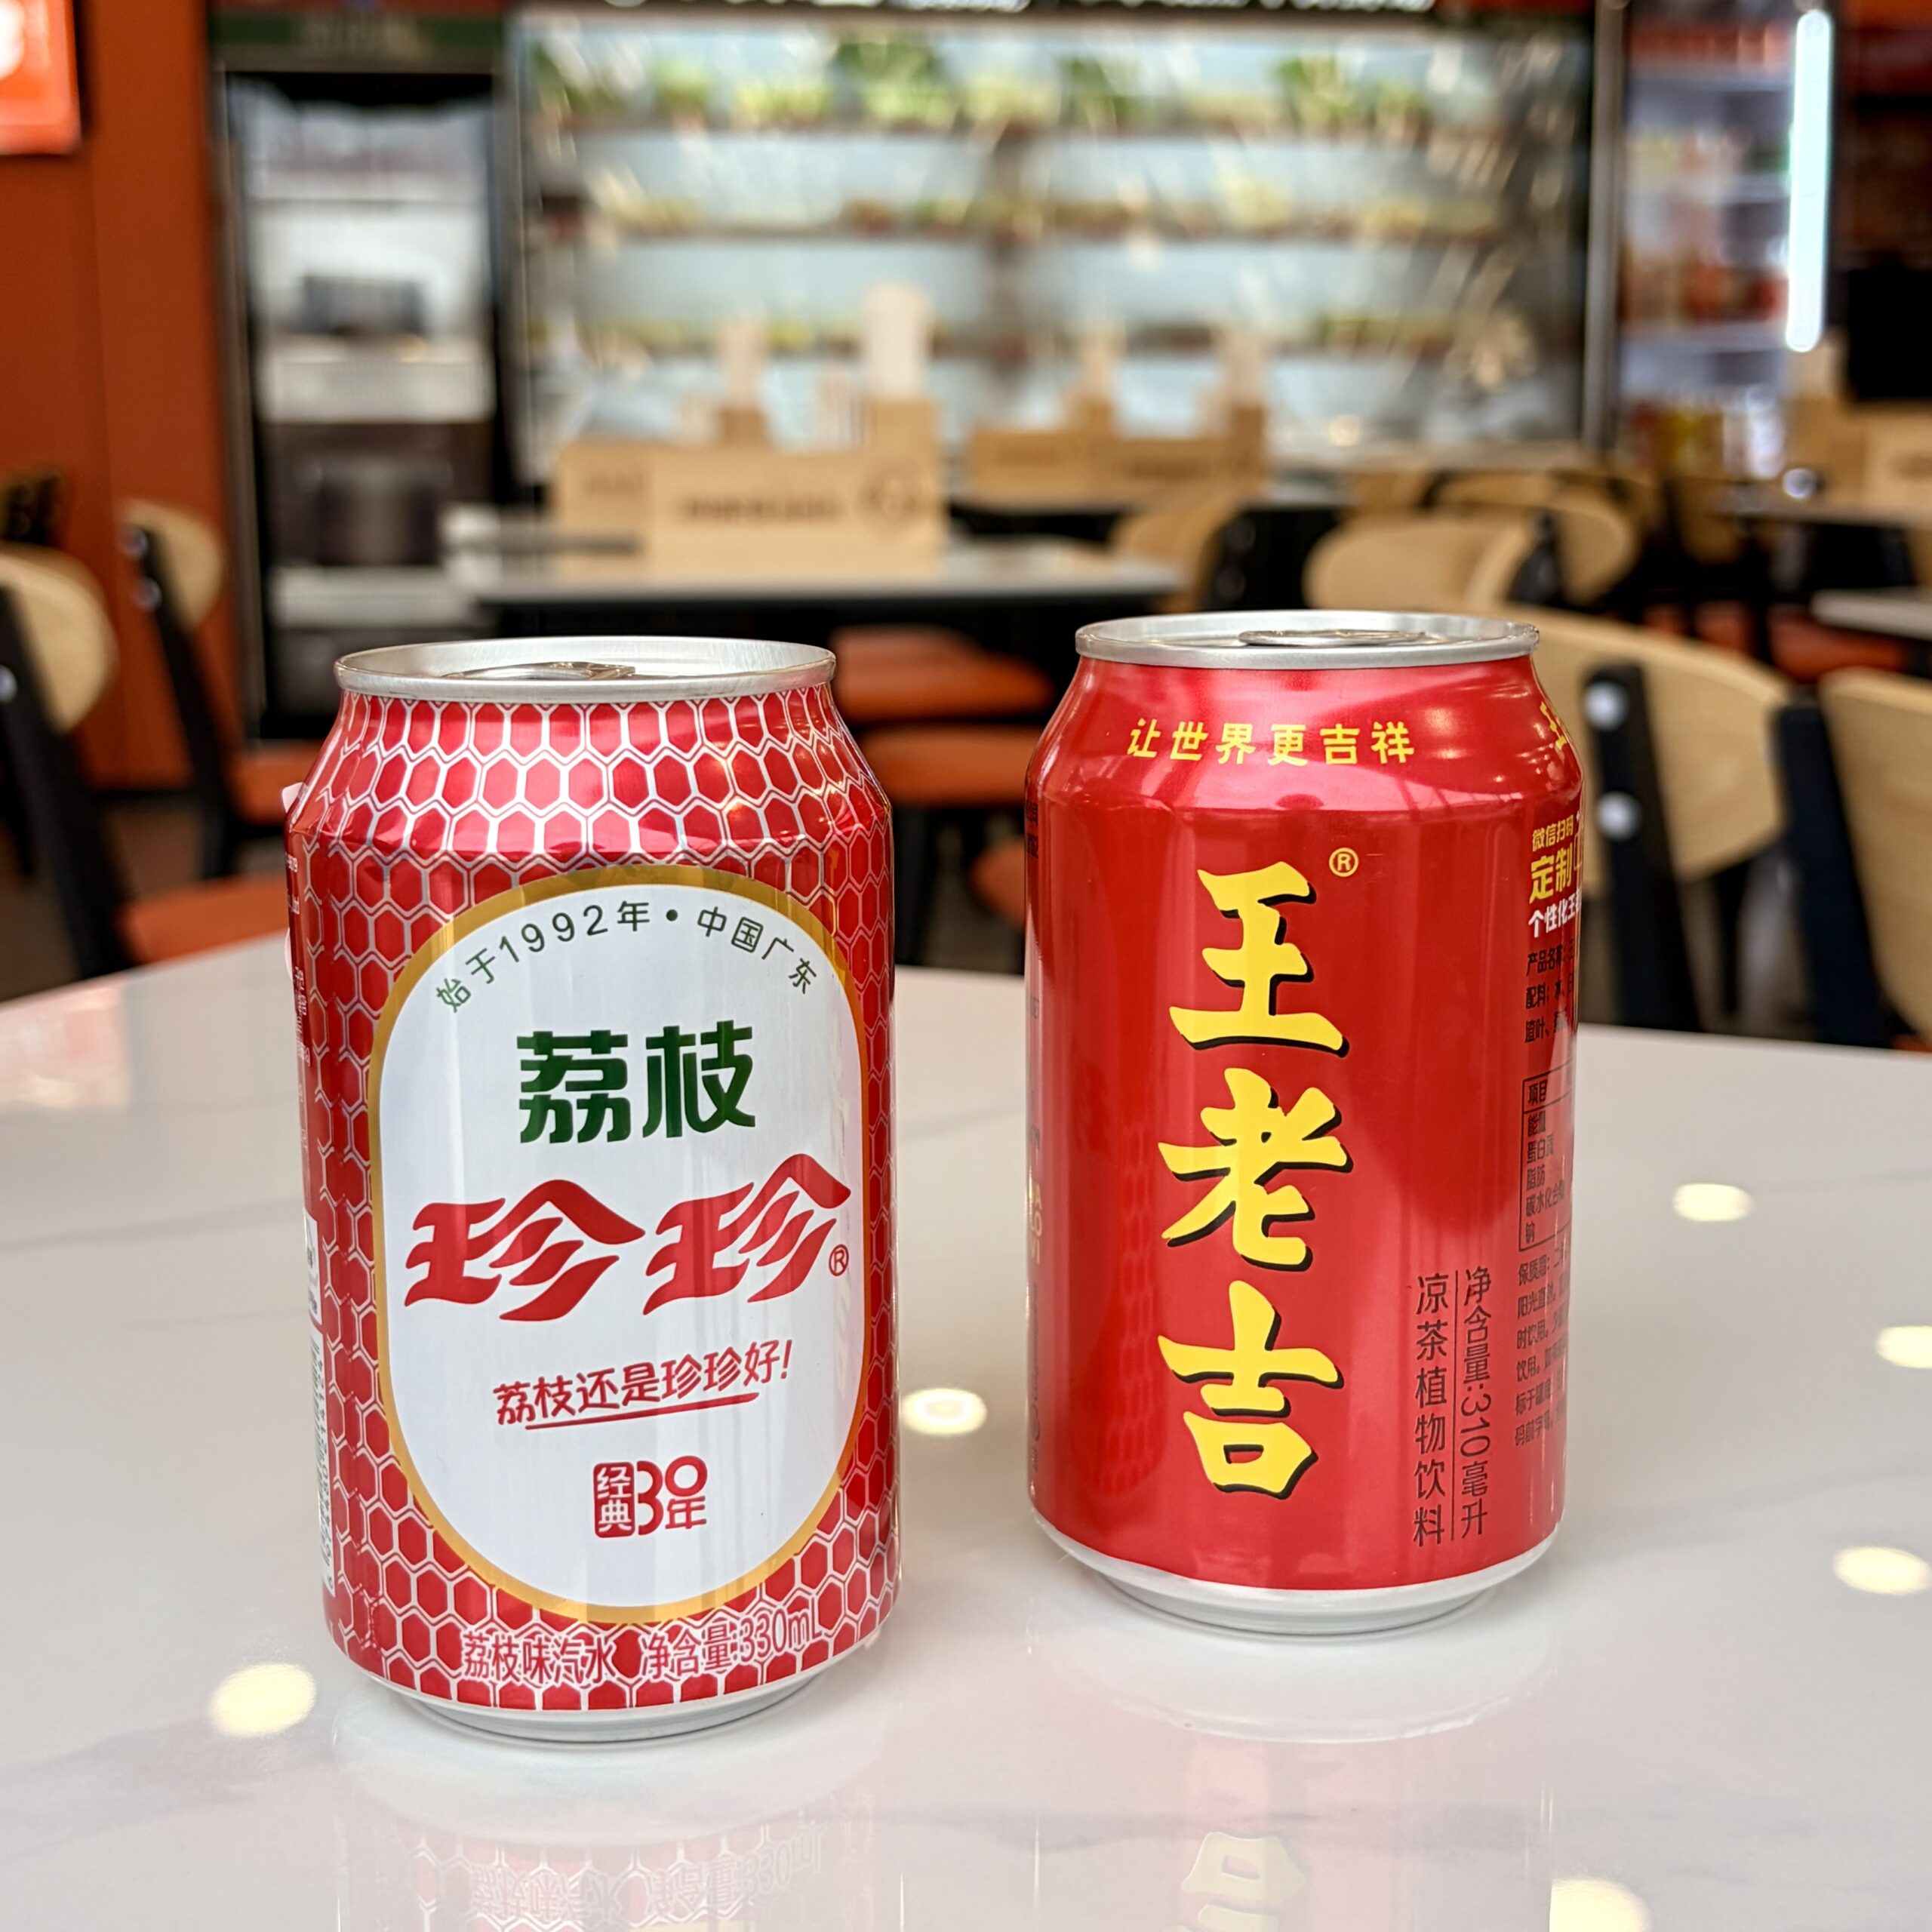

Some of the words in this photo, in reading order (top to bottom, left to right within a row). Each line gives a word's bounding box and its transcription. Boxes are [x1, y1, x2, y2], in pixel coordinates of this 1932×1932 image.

[1128, 718, 1415, 766] 让世界更吉祥
[516, 1019, 756, 1144] 荔枝
[1527, 1078, 1548, 1105] 项目
[1158, 861, 1354, 1500] 王老吉
[405, 1153, 851, 1322] 珍珍
[494, 1340, 792, 1425] 荔枝还是珍珍好!
[1413, 1272, 1449, 1547] 凉茶植物饮料
[1460, 1265, 1492, 1540] 净含量:310毫升
[595, 1464, 635, 1535] 经典
[463, 1631, 616, 1687] 荔枝味汽水
[640, 1607, 822, 1681] 净含量:330mL
